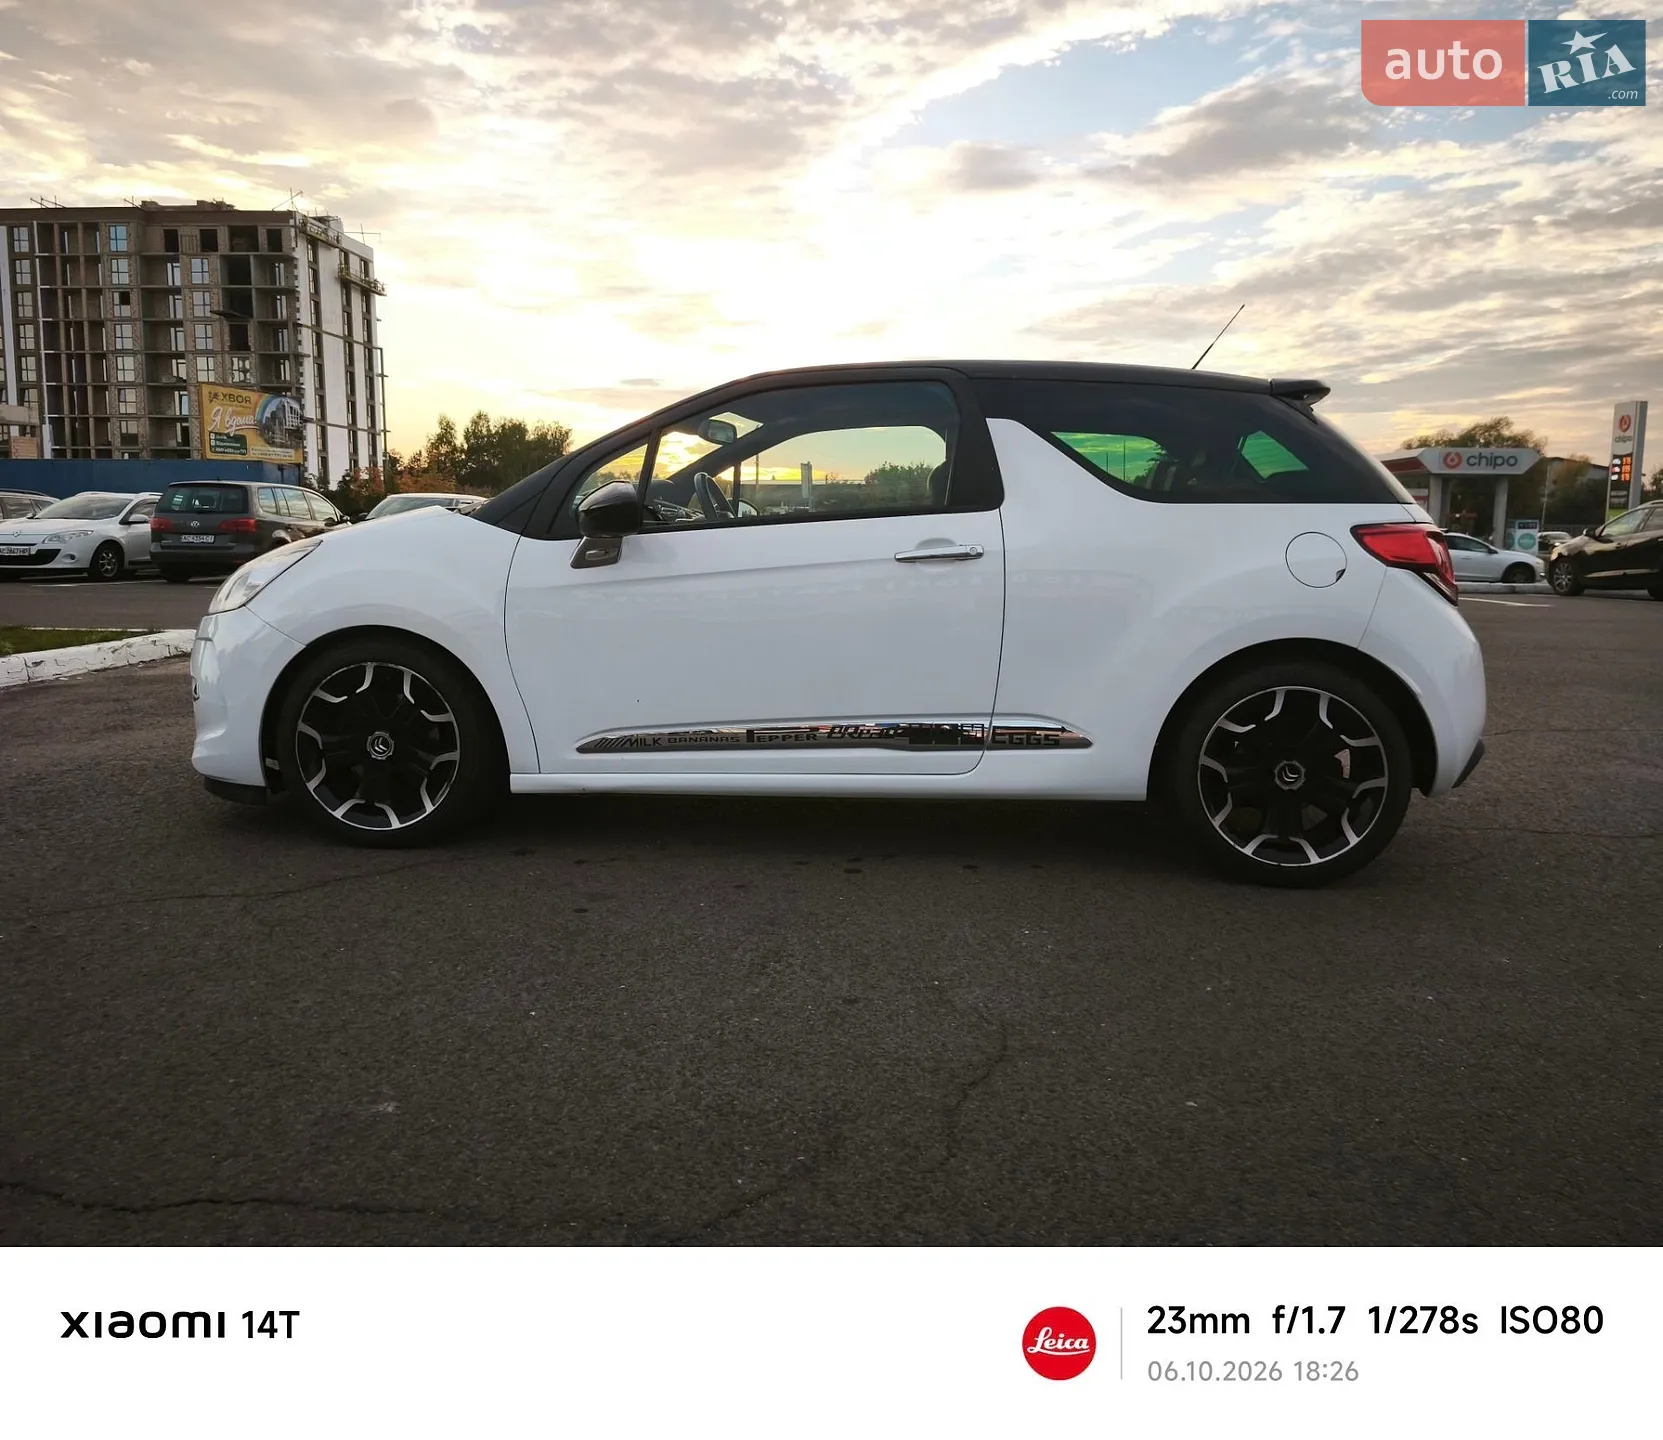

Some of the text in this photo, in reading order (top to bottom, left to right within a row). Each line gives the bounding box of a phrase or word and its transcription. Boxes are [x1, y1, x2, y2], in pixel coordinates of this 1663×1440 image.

[221, 393, 252, 405] ХВОЯ
[208, 406, 223, 432] Я
[1466, 452, 1518, 470] chipo
[620, 736, 663, 748] MILK
[667, 736, 741, 744] BANANAS
